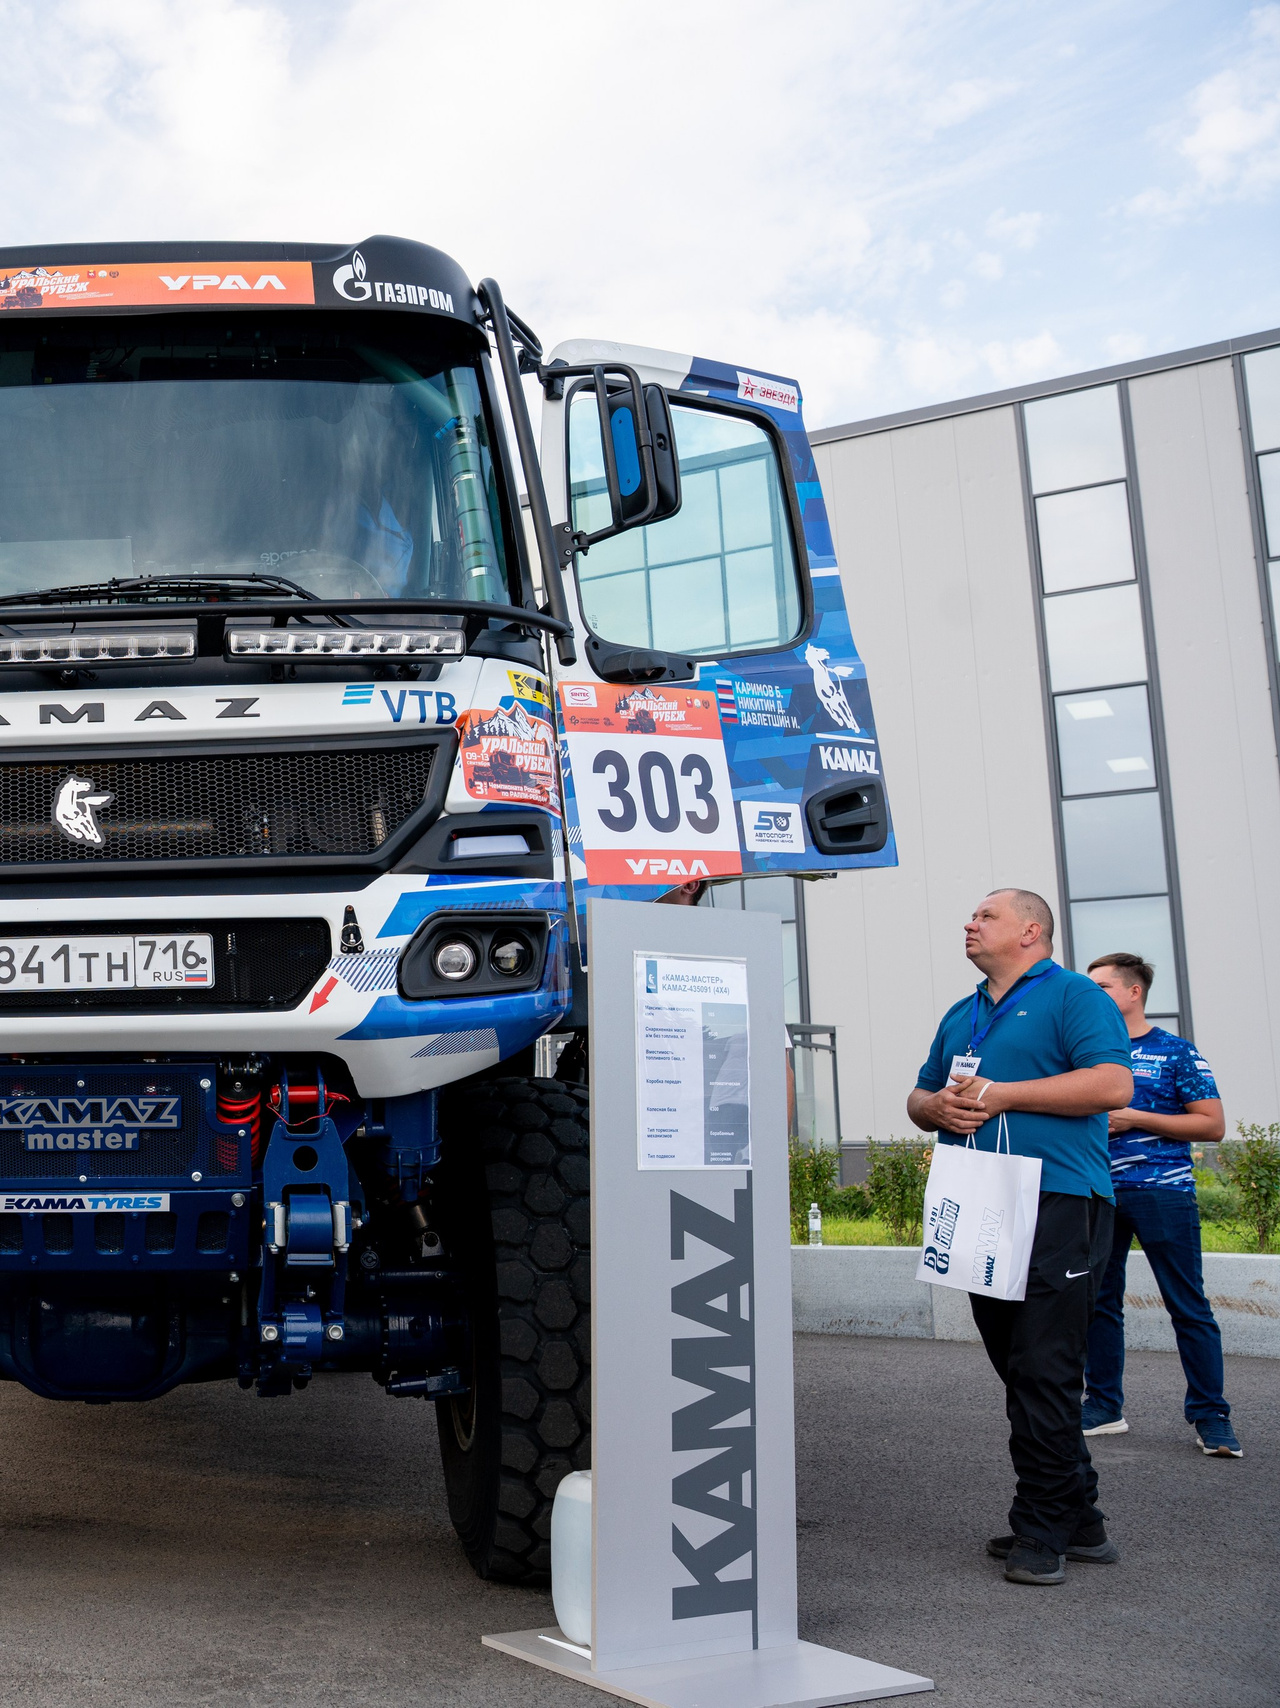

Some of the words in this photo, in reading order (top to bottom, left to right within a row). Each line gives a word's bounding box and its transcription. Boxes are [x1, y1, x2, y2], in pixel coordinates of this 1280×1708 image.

[10, 273, 81, 289] УРАЛЬСКИЙ
[40, 281, 90, 295] РУБЕЖ
[158, 274, 286, 291] УРАЛ
[374, 282, 455, 313] ГАЗПРОМ
[759, 386, 796, 406] ЗВЕЗДА
[734, 681, 775, 698] КАРИМОВ
[774, 685, 784, 699] Б.
[379, 689, 459, 725] VTB
[629, 700, 678, 711] УРАЛЬСКИЙ
[737, 696, 776, 712] НИКИТИН
[776, 700, 786, 715] Д.
[652, 710, 686, 722] РУБЕЖ
[740, 711, 791, 729] ДАВЛЕТШИН
[790, 716, 801, 729] И.
[465, 751, 490, 761] 09-13
[481, 737, 545, 756] УРАЛЬСКИЙ
[515, 754, 552, 773] РУБЕЖ
[818, 745, 880, 775] KAMAZ
[474, 781, 485, 795] 3
[592, 749, 720, 835] 303
[624, 857, 711, 876] УРАЛ
[138, 939, 202, 970] 716
[153, 970, 184, 982] RUS
[661, 973, 724, 984] «КАМАЗ-МАСТЕР»
[661, 983, 712, 994] KAMAZ-435091
[27, 1129, 139, 1150] master
[929, 1206, 939, 1227] 1991
[983, 1255, 996, 1287] KAMAZ
[670, 1188, 758, 1622] KAMAZ
